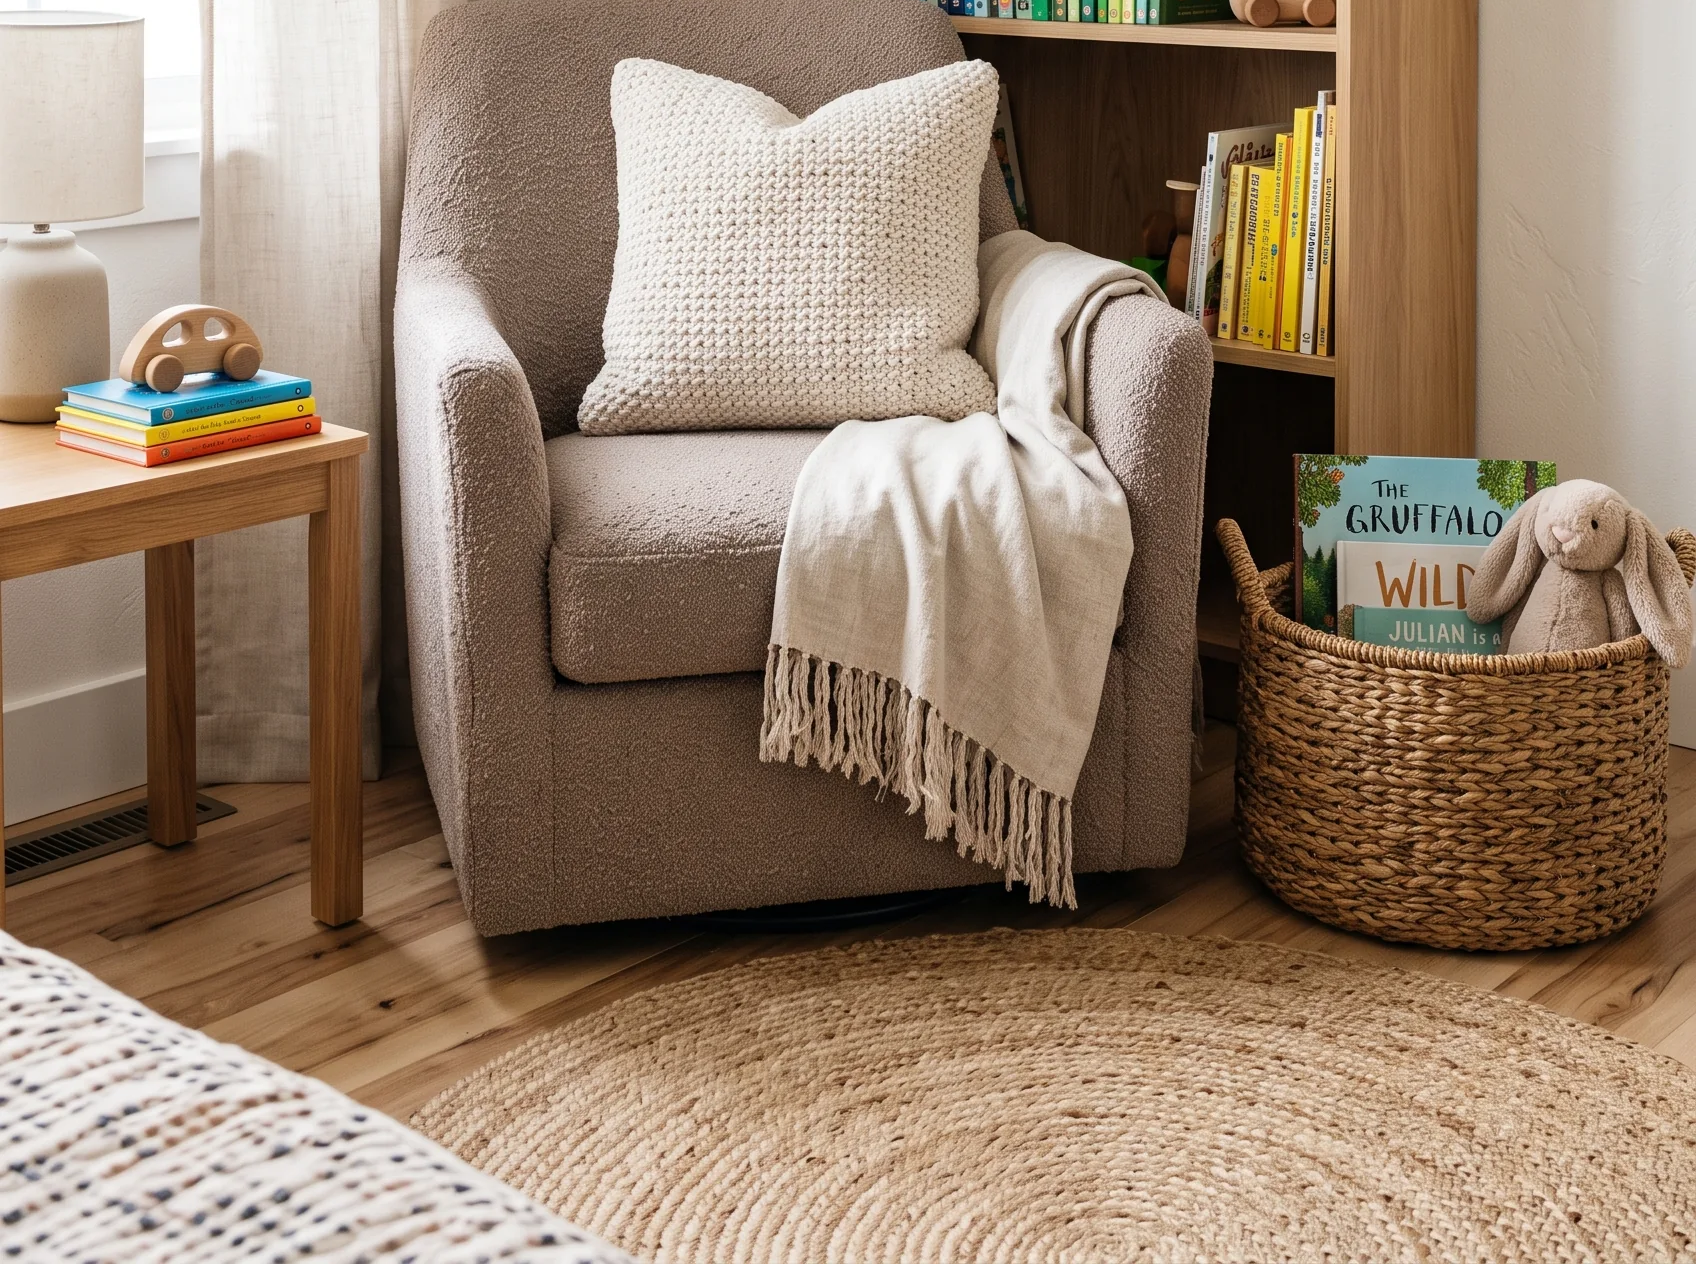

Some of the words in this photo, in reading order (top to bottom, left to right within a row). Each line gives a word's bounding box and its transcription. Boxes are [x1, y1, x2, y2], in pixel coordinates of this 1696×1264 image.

[1371, 479, 1409, 499] THE
[1345, 503, 1503, 538] GRUFFALO
[1388, 620, 1465, 644] JULIAN
[1472, 628, 1486, 645] is
[1492, 633, 1501, 645] a
